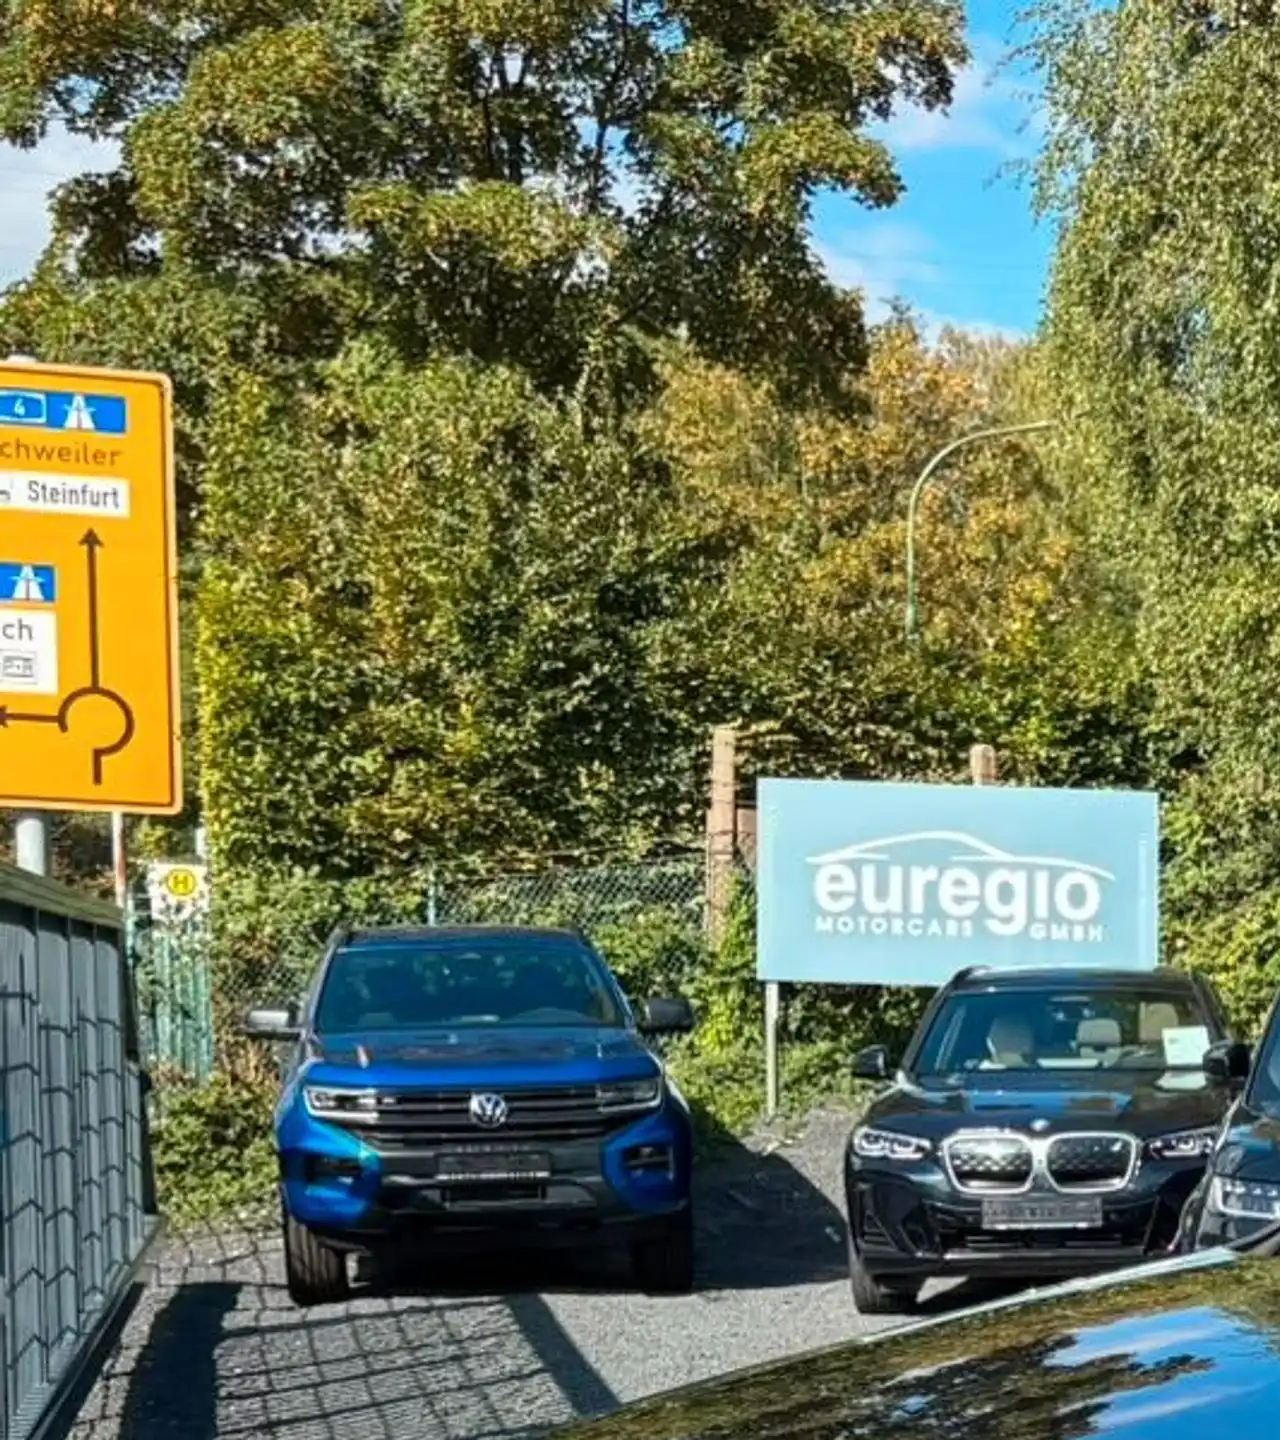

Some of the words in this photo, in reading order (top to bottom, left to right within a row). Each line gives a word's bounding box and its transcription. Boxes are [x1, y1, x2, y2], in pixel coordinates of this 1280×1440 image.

[28, 479, 119, 510] Steinfurt
[813, 862, 1102, 936] euregio
[814, 914, 974, 938] MOTORCARS
